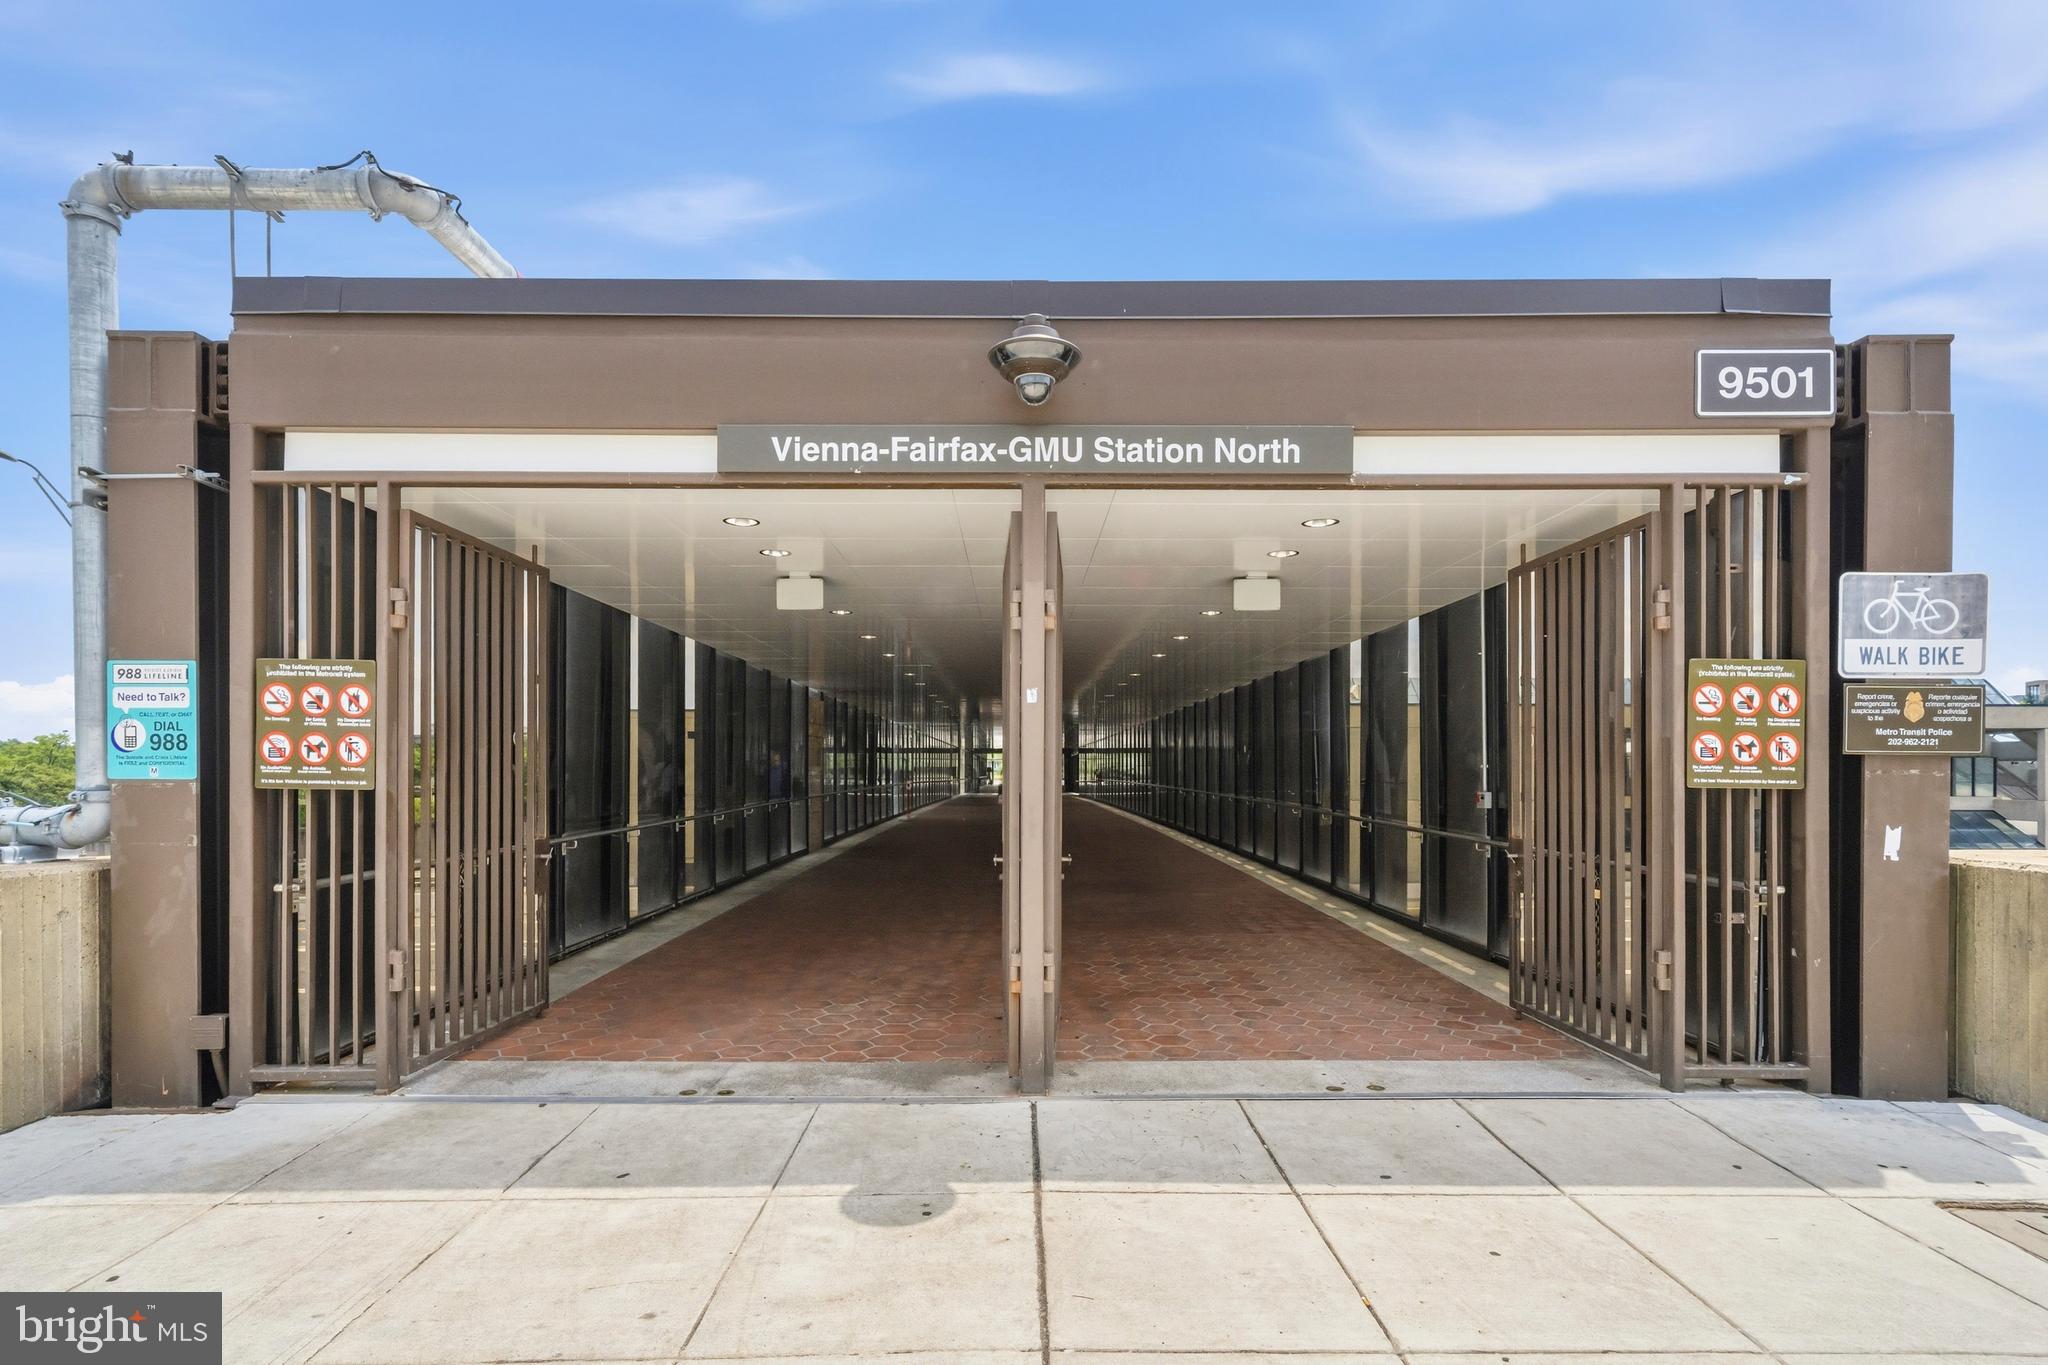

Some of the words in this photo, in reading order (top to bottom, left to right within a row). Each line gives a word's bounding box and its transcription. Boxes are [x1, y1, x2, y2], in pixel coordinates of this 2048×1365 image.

[1718, 366, 1814, 399] 9501
[770, 436, 1084, 465] Vienna-Fairfax-GMU
[1093, 436, 1203, 465] Station
[1213, 437, 1301, 465] North
[1859, 646, 1908, 665] WALK
[1919, 646, 1964, 665] BIKE
[117, 668, 142, 679] 988
[117, 692, 144, 701] Need
[147, 693, 157, 701] to
[159, 692, 186, 701] Talk?
[154, 721, 184, 731] DIAL
[1875, 728, 1898, 736] Metro
[1899, 728, 1927, 736] Transit
[1928, 728, 1953, 736] Police
[150, 733, 188, 751] 988
[1887, 738, 1939, 746] 202-962-2121
